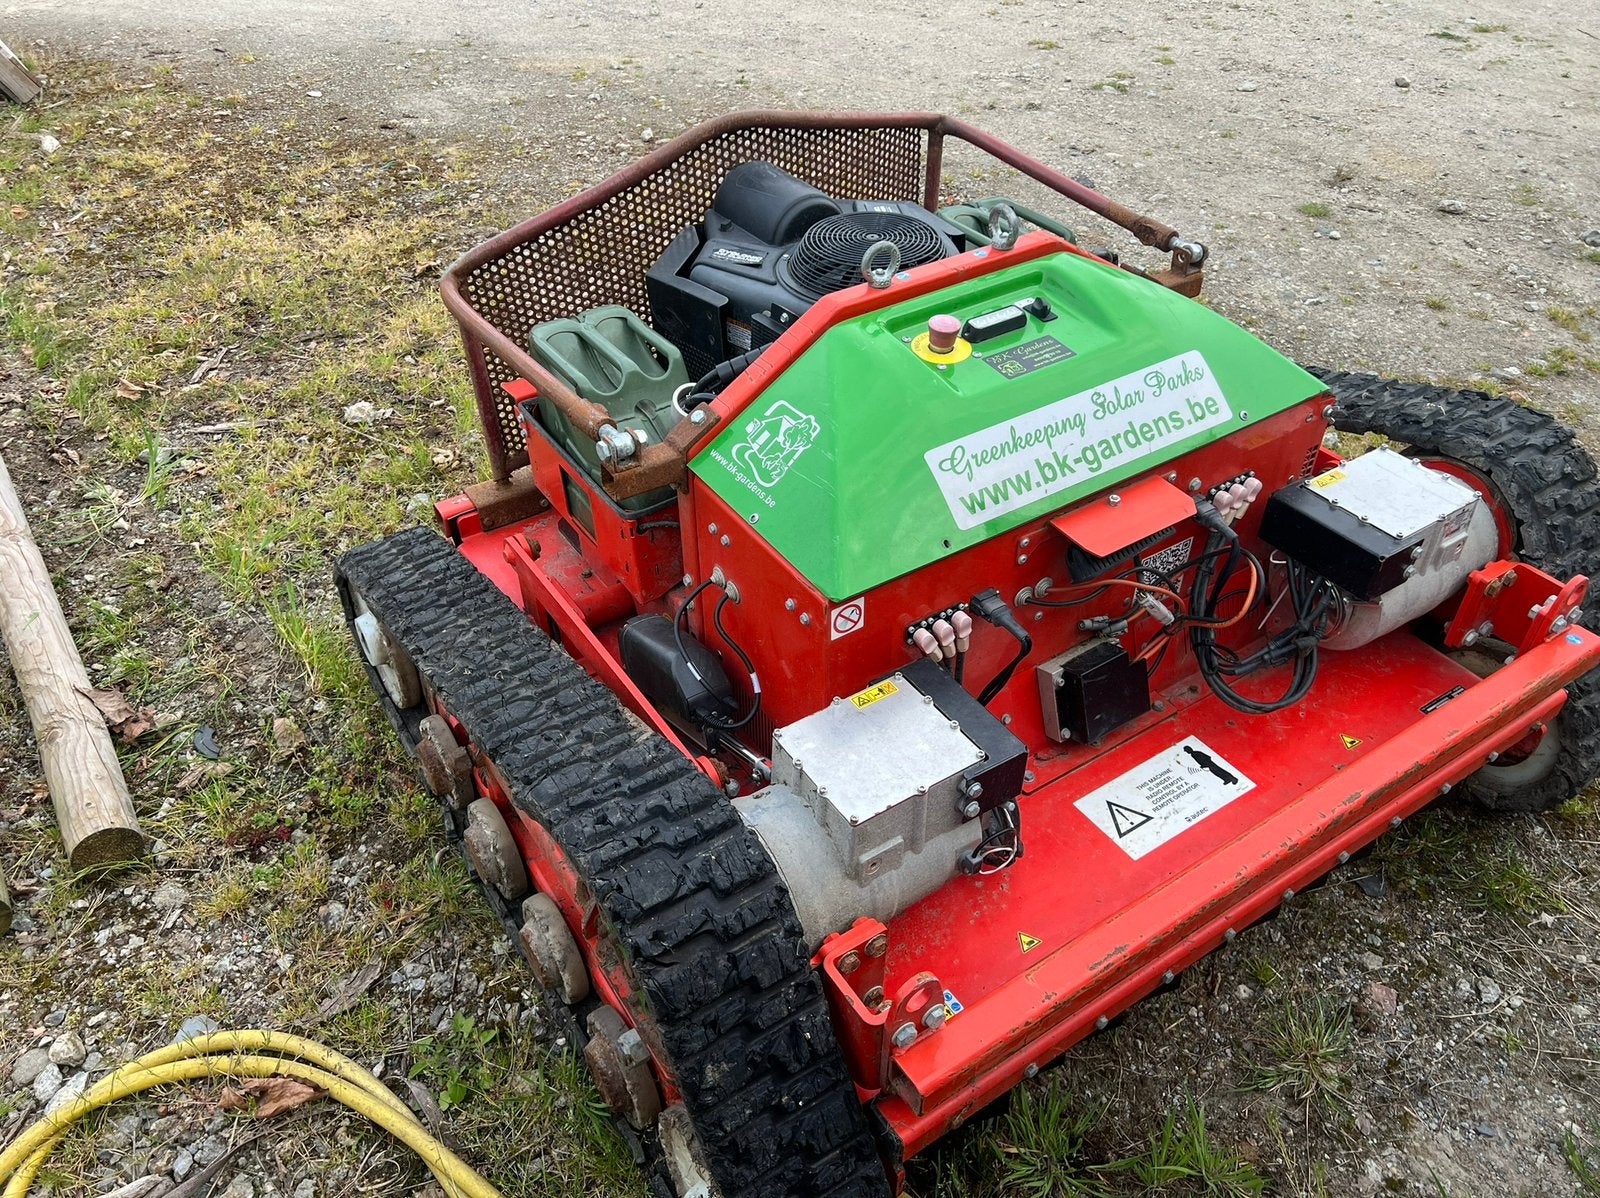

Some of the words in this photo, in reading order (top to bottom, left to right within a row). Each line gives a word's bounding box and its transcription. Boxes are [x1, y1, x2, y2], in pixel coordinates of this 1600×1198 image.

[1017, 339, 1054, 355] Gardens
[939, 409, 1086, 481] Greenkeeping
[1091, 385, 1144, 420] Solar
[1144, 360, 1204, 396] Parks
[958, 394, 1220, 515] www.bk-gardens.be
[710, 449, 776, 508] www.bk-gardens.be
[1136, 781, 1149, 791] THIS
[1148, 768, 1173, 784] MACHINE
[1145, 789, 1163, 801] RADIO
[1162, 776, 1185, 792] REMOTE
[1154, 775, 1173, 789] UNDER
[1151, 789, 1177, 805] CONTROL
[1176, 783, 1185, 791] BY
[1151, 798, 1175, 813] REMOTE
[1172, 783, 1200, 800] OPERATOR
[1190, 806, 1209, 820] autec
